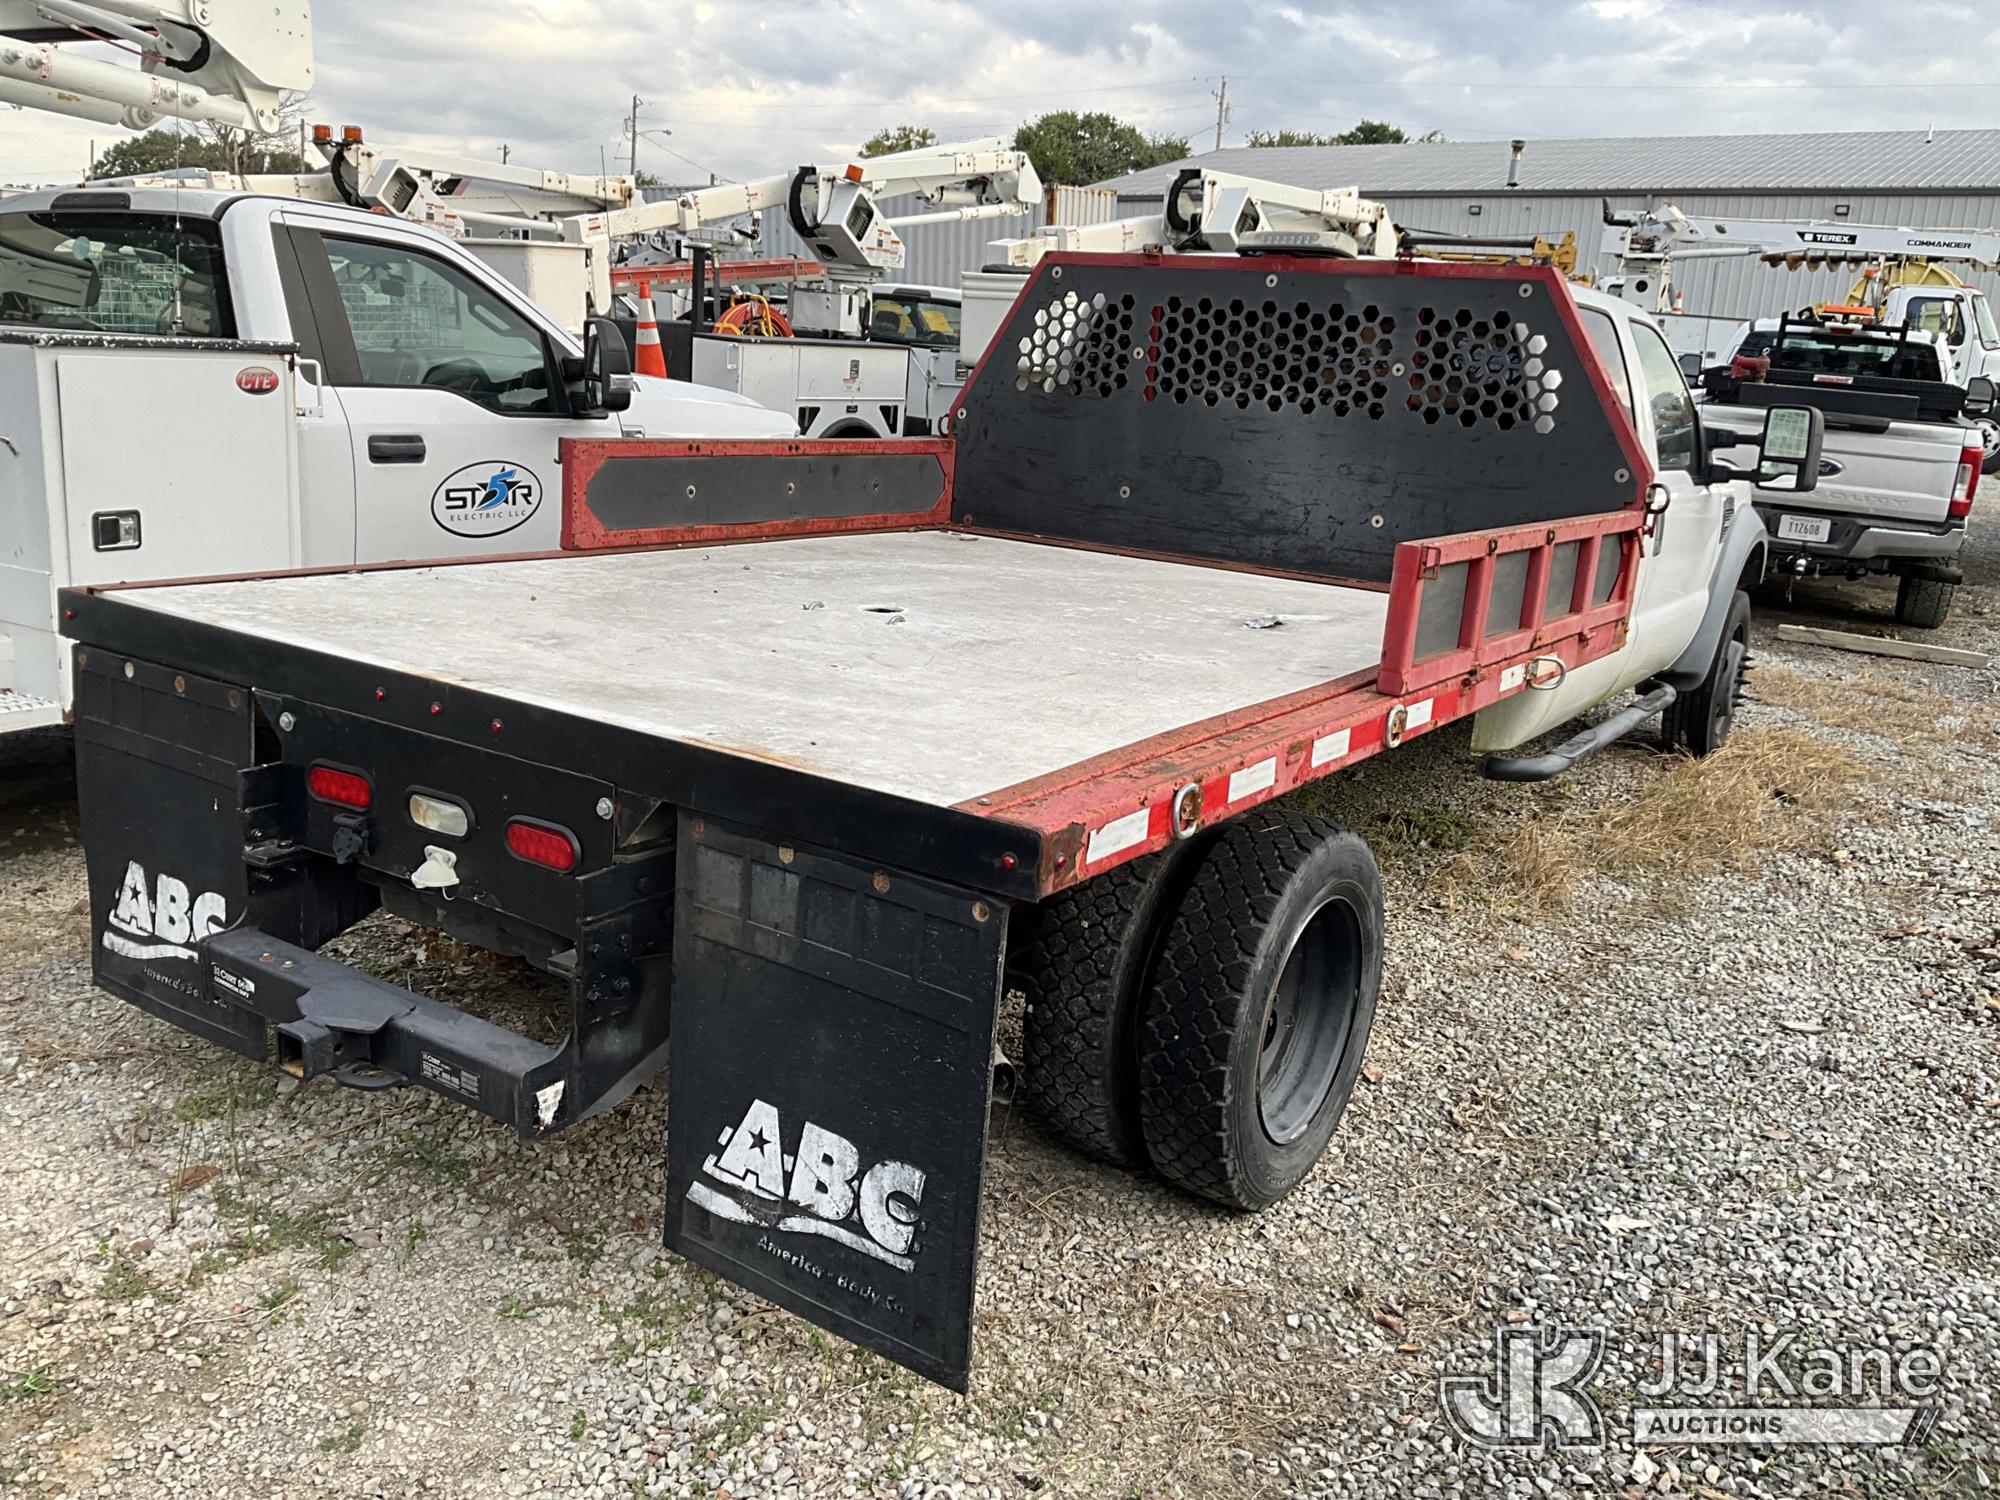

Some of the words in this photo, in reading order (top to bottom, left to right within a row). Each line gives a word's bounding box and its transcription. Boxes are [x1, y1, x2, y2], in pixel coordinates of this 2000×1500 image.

[1815, 234, 1850, 243] TEREX
[1906, 239, 1972, 250] COMMANDER
[450, 511, 503, 522] ELECTRIC
[508, 509, 526, 518] LLC
[716, 1098, 926, 1254] ABC
